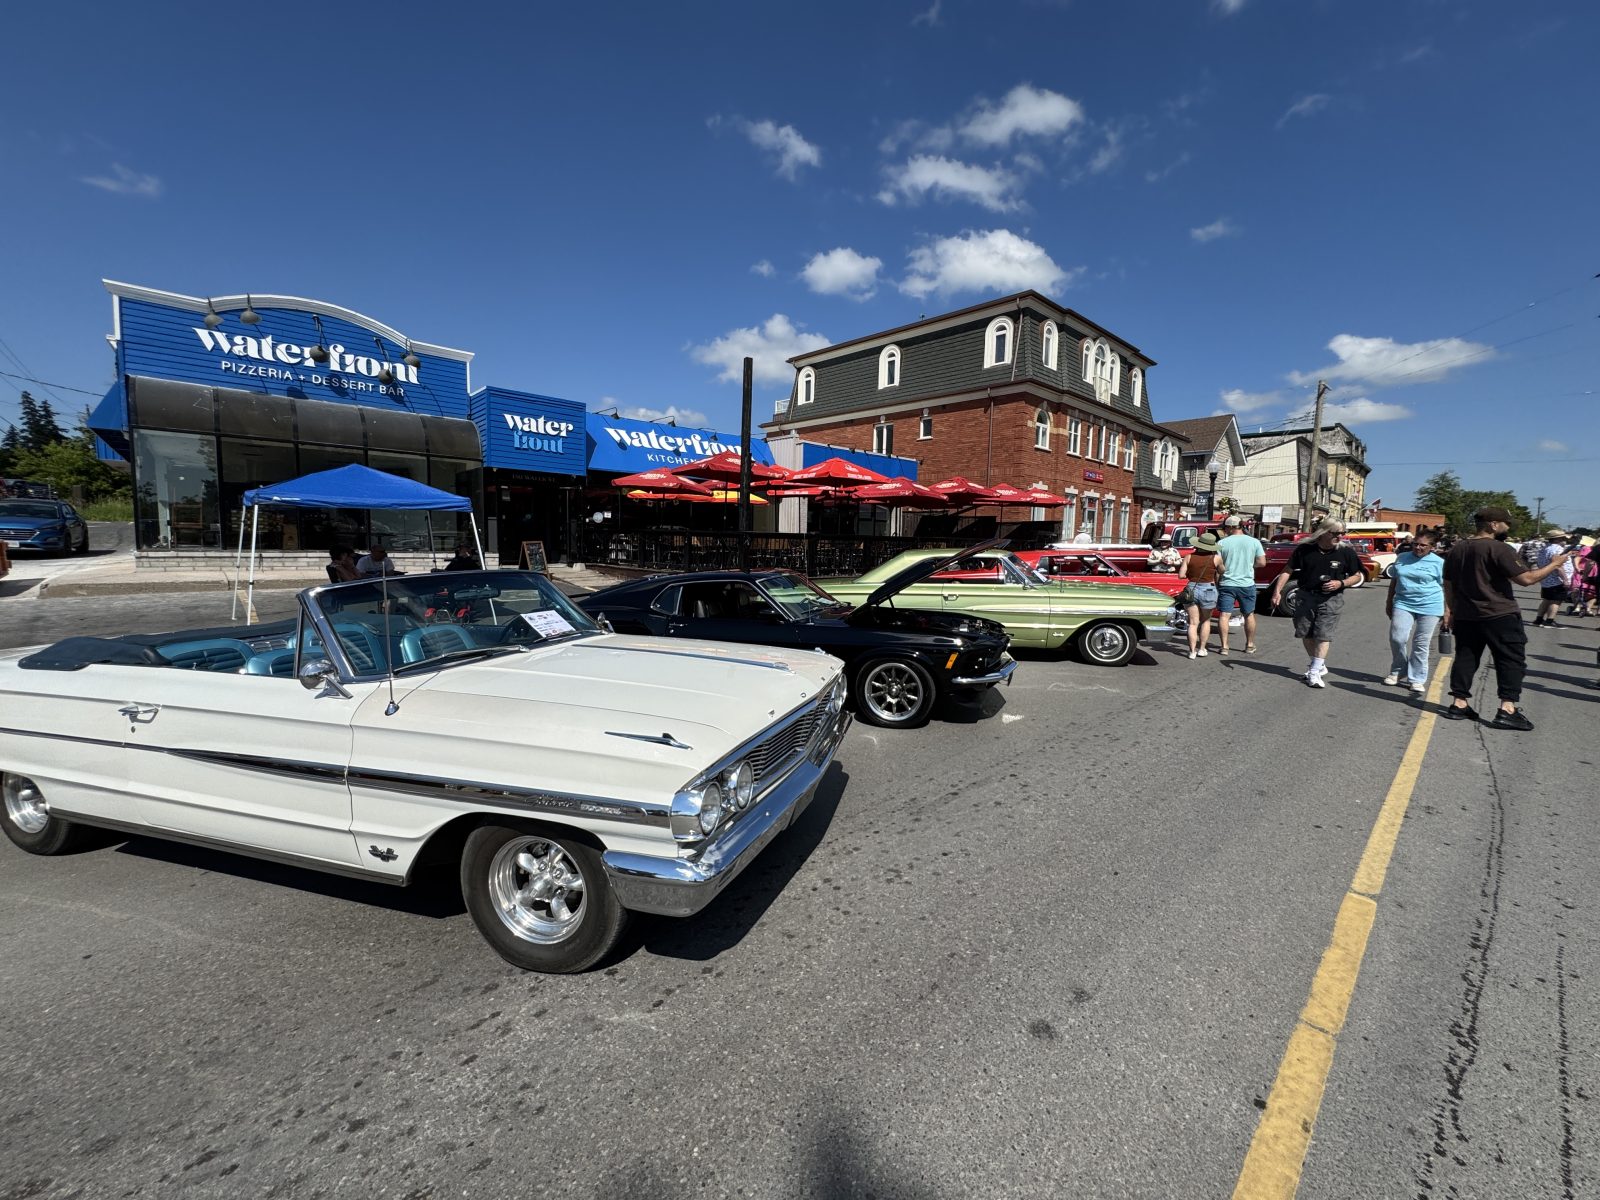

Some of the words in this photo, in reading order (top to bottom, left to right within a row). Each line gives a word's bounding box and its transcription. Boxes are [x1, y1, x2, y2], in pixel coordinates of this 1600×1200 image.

[221, 361, 293, 381] PIZZERIA
[312, 374, 374, 393] DESSERT
[379, 385, 404, 397] BAR
[503, 413, 573, 437] water
[513, 430, 564, 454] front
[604, 427, 742, 457] waterfron
